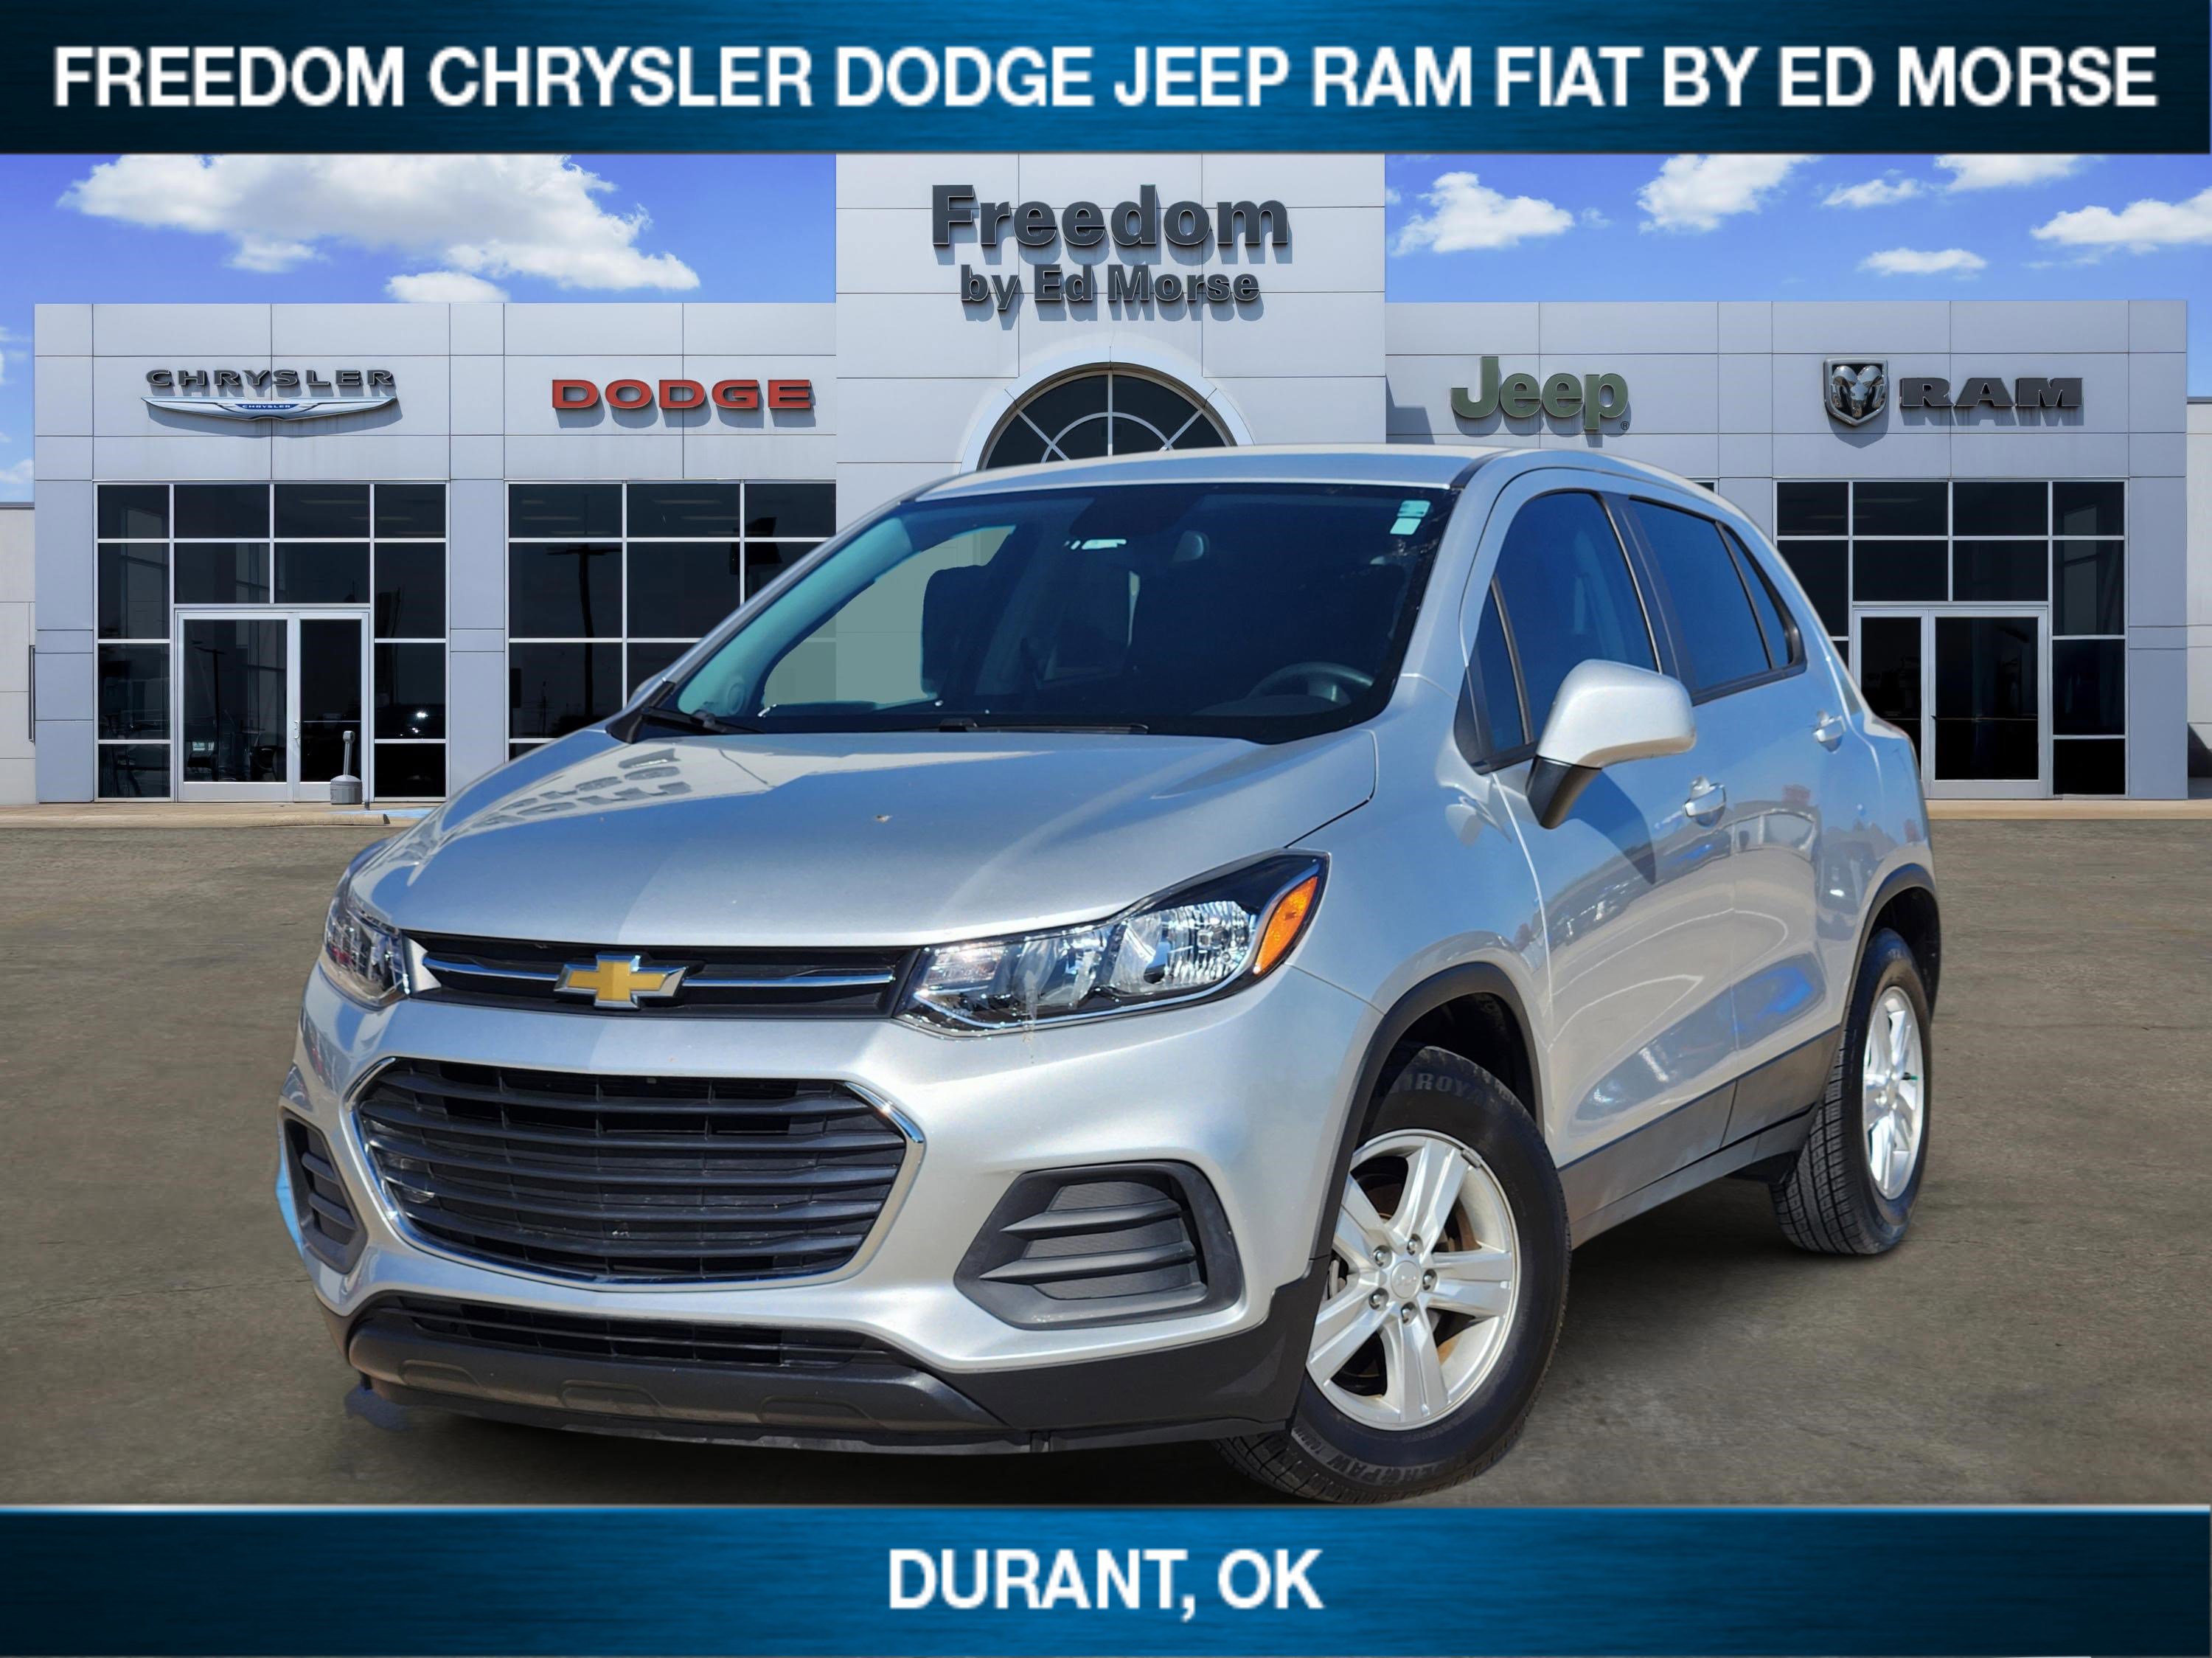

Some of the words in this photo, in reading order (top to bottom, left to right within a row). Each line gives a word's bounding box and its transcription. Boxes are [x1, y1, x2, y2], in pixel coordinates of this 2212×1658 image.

[932, 184, 1289, 246] Freedom
[961, 264, 1018, 311] by
[1034, 264, 1093, 302] Ed
[1107, 264, 1260, 302] Morse
[145, 369, 394, 387] CHRYSLER
[552, 378, 812, 409] DODGE
[1450, 356, 1629, 430] Jeep
[1899, 377, 2083, 408] RAM
